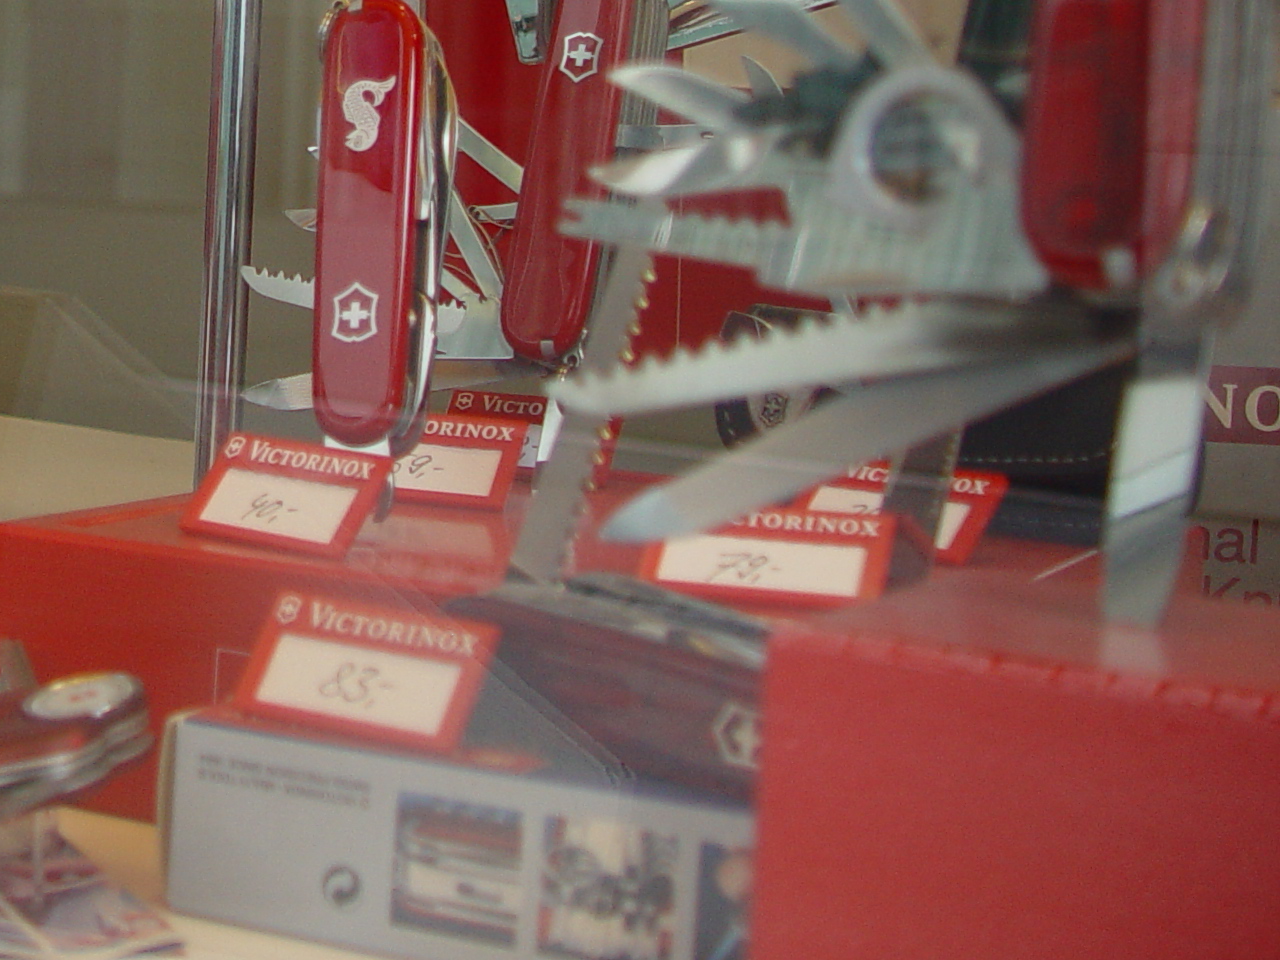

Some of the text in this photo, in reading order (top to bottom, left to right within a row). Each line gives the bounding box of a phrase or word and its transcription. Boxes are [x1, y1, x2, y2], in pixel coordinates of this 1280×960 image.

[424, 420, 515, 442] ORINOX
[251, 440, 376, 480] VICTORINOX
[311, 602, 479, 657] VICTORINOX
